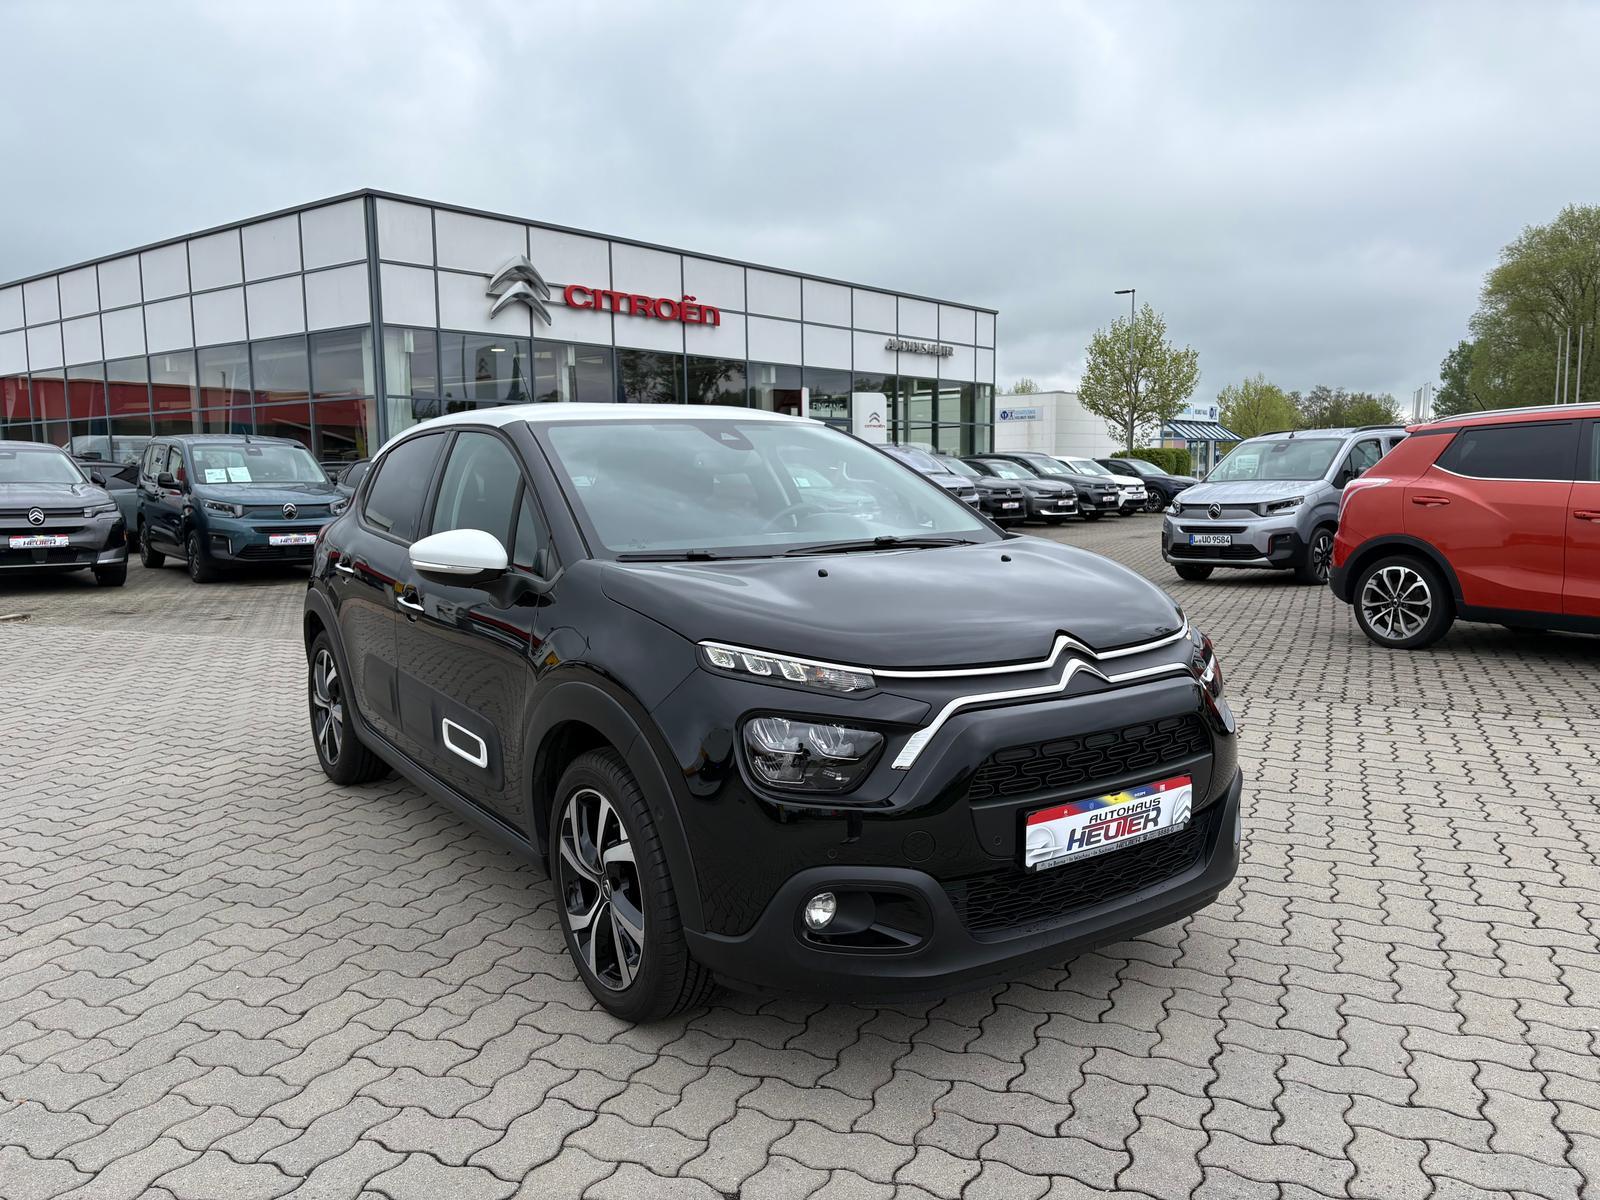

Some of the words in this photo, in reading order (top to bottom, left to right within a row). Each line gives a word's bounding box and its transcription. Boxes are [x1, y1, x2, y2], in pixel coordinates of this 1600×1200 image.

[564, 285, 720, 326] CITROËN
[812, 402, 844, 411] EINGANG
[1089, 797, 1161, 824] AUTOHAUS
[1066, 806, 1161, 851] HEUTER
